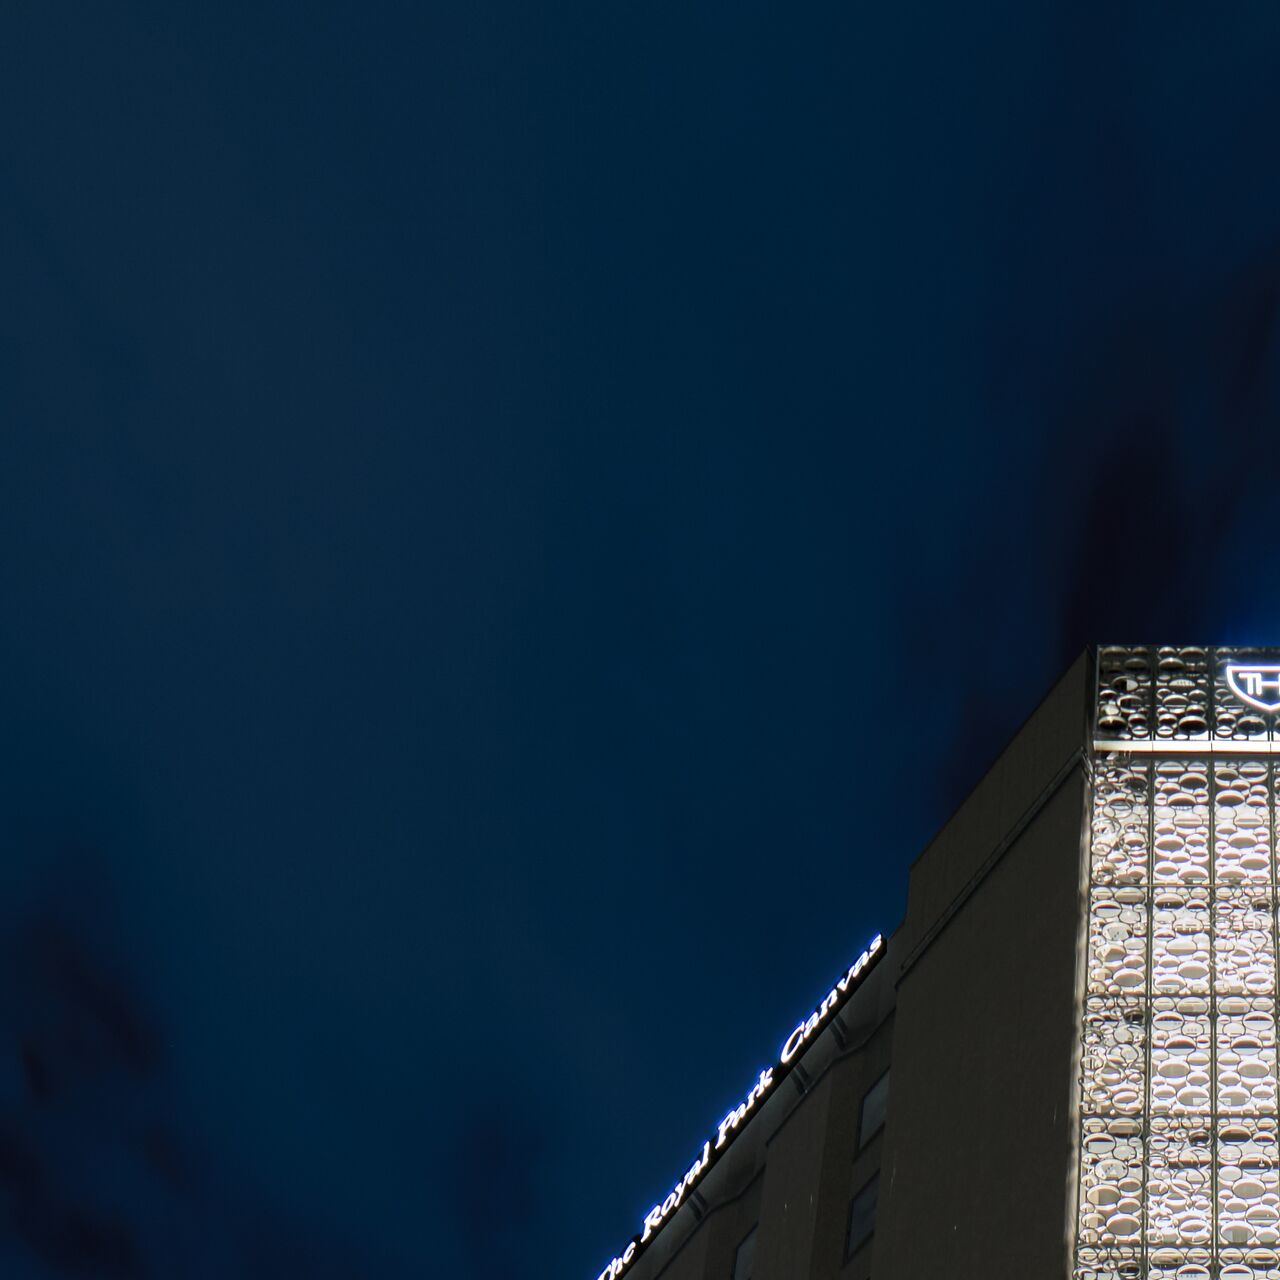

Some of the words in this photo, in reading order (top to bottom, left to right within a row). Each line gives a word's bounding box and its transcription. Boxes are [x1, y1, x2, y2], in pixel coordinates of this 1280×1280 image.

[640, 1140, 711, 1242] Royal
[714, 1066, 774, 1149] Park
[780, 931, 884, 1064] Canvas
